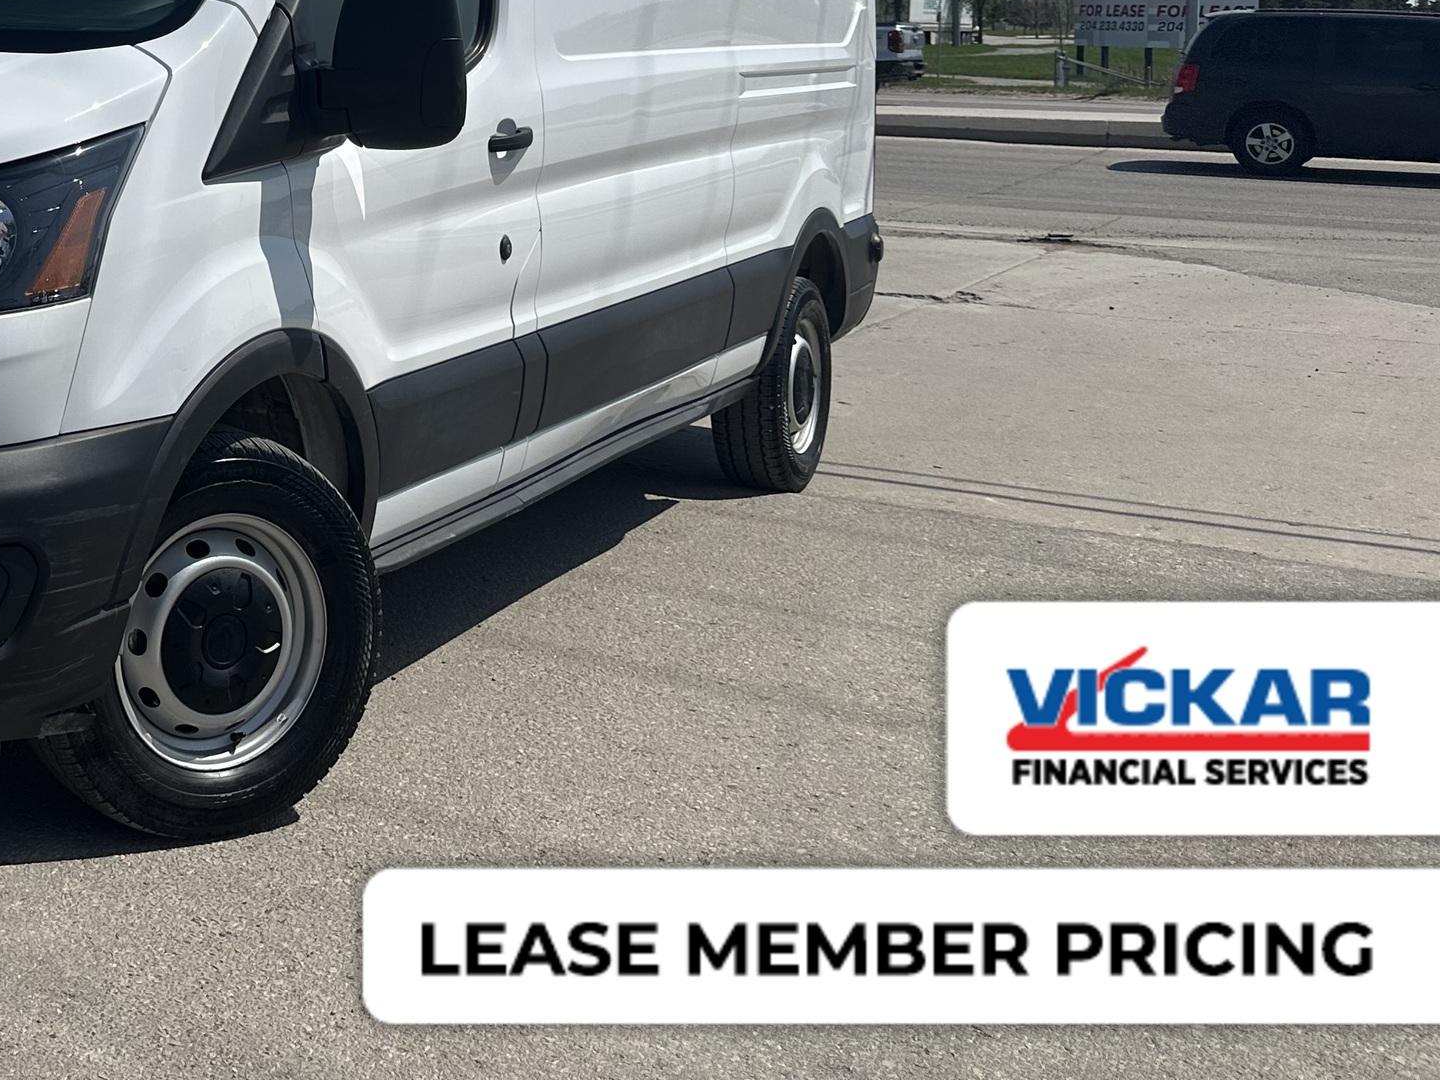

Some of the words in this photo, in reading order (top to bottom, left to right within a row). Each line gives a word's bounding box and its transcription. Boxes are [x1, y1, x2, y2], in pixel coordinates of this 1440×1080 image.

[1079, 4, 1103, 17] FOR
[1106, 4, 1146, 18] LEASE
[1080, 21, 1145, 32] 204.233.4330
